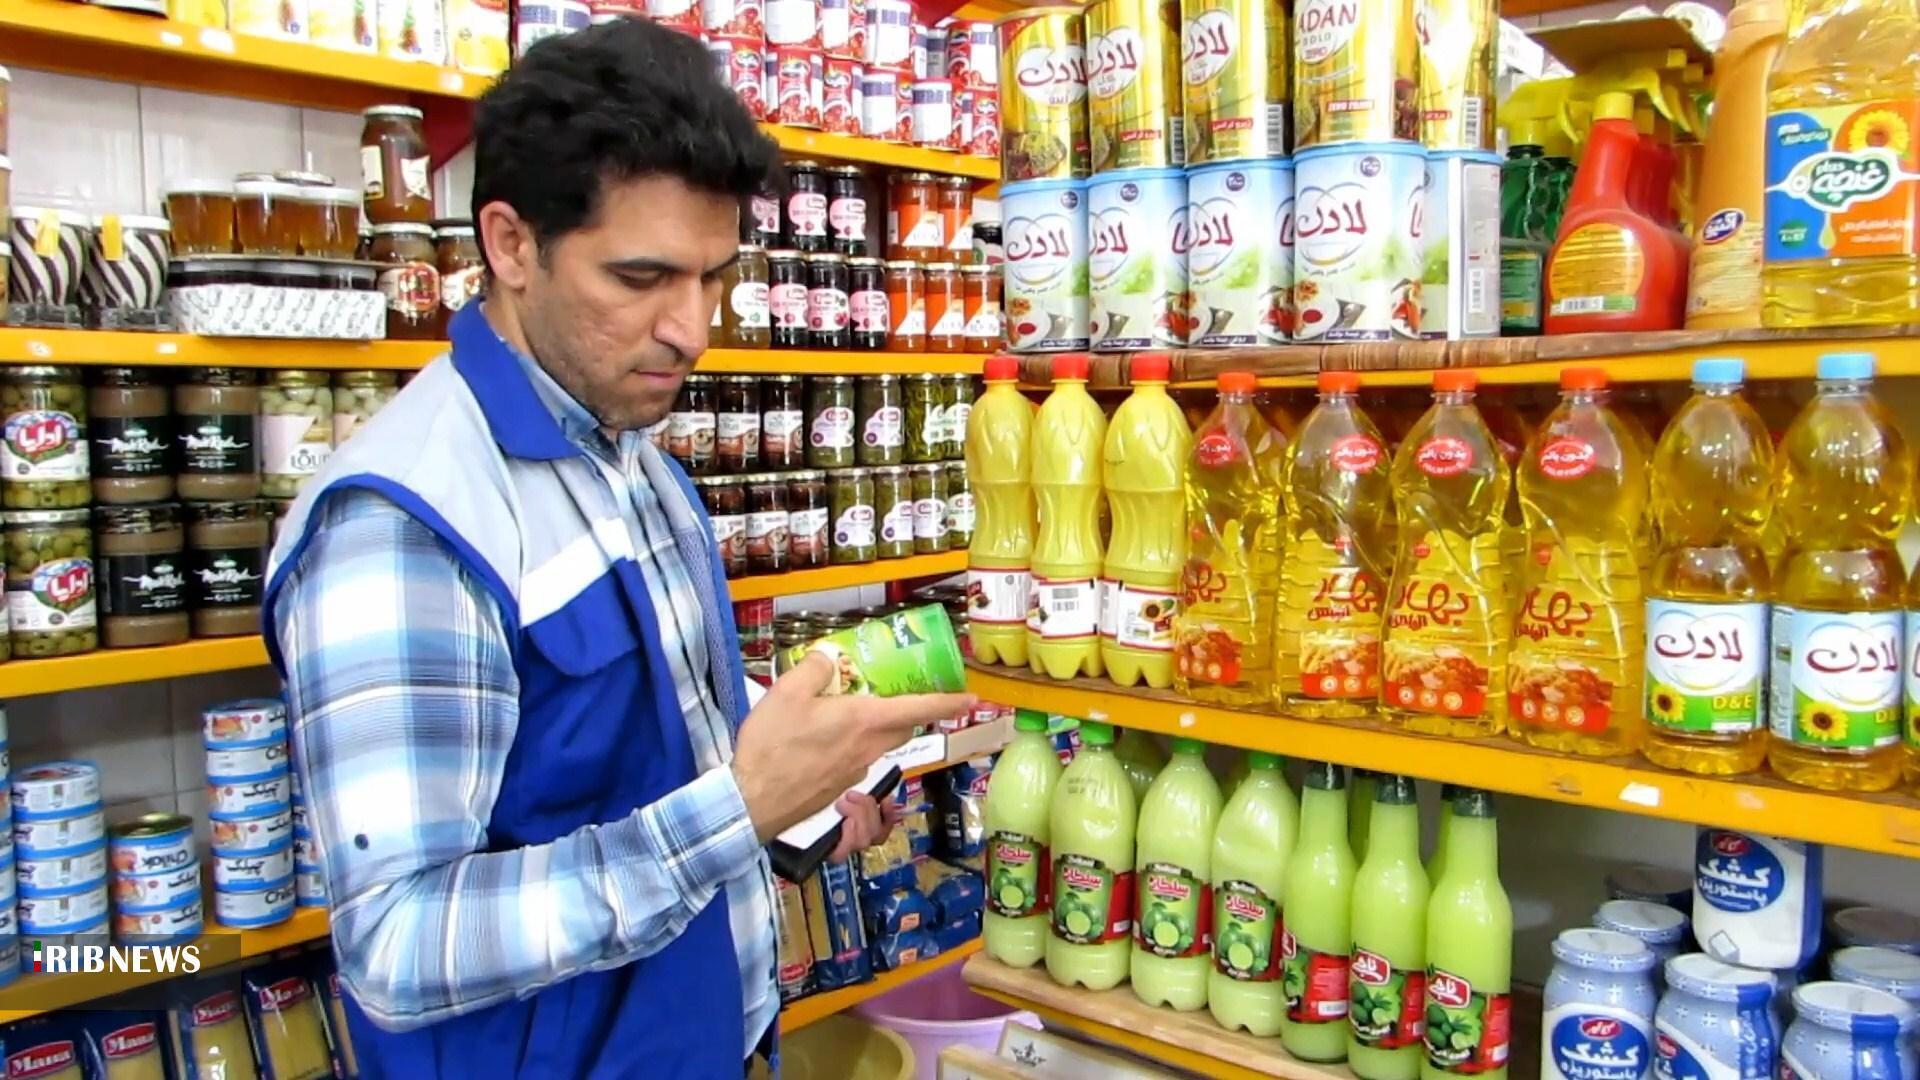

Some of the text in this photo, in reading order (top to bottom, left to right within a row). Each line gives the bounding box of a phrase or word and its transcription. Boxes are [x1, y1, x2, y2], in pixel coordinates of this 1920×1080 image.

[1018, 57, 1088, 87] لادن
[1812, 162, 1886, 202] غنچه
[1297, 199, 1368, 238] لادن
[1006, 229, 1070, 262] لادن
[1394, 580, 1470, 626] بهار
[1519, 586, 1594, 638] بهار
[1654, 629, 1743, 662] لادن
[1806, 637, 1899, 673] لادن
[1699, 858, 1771, 889] کشک
[1560, 1041, 1640, 1067] کشک
